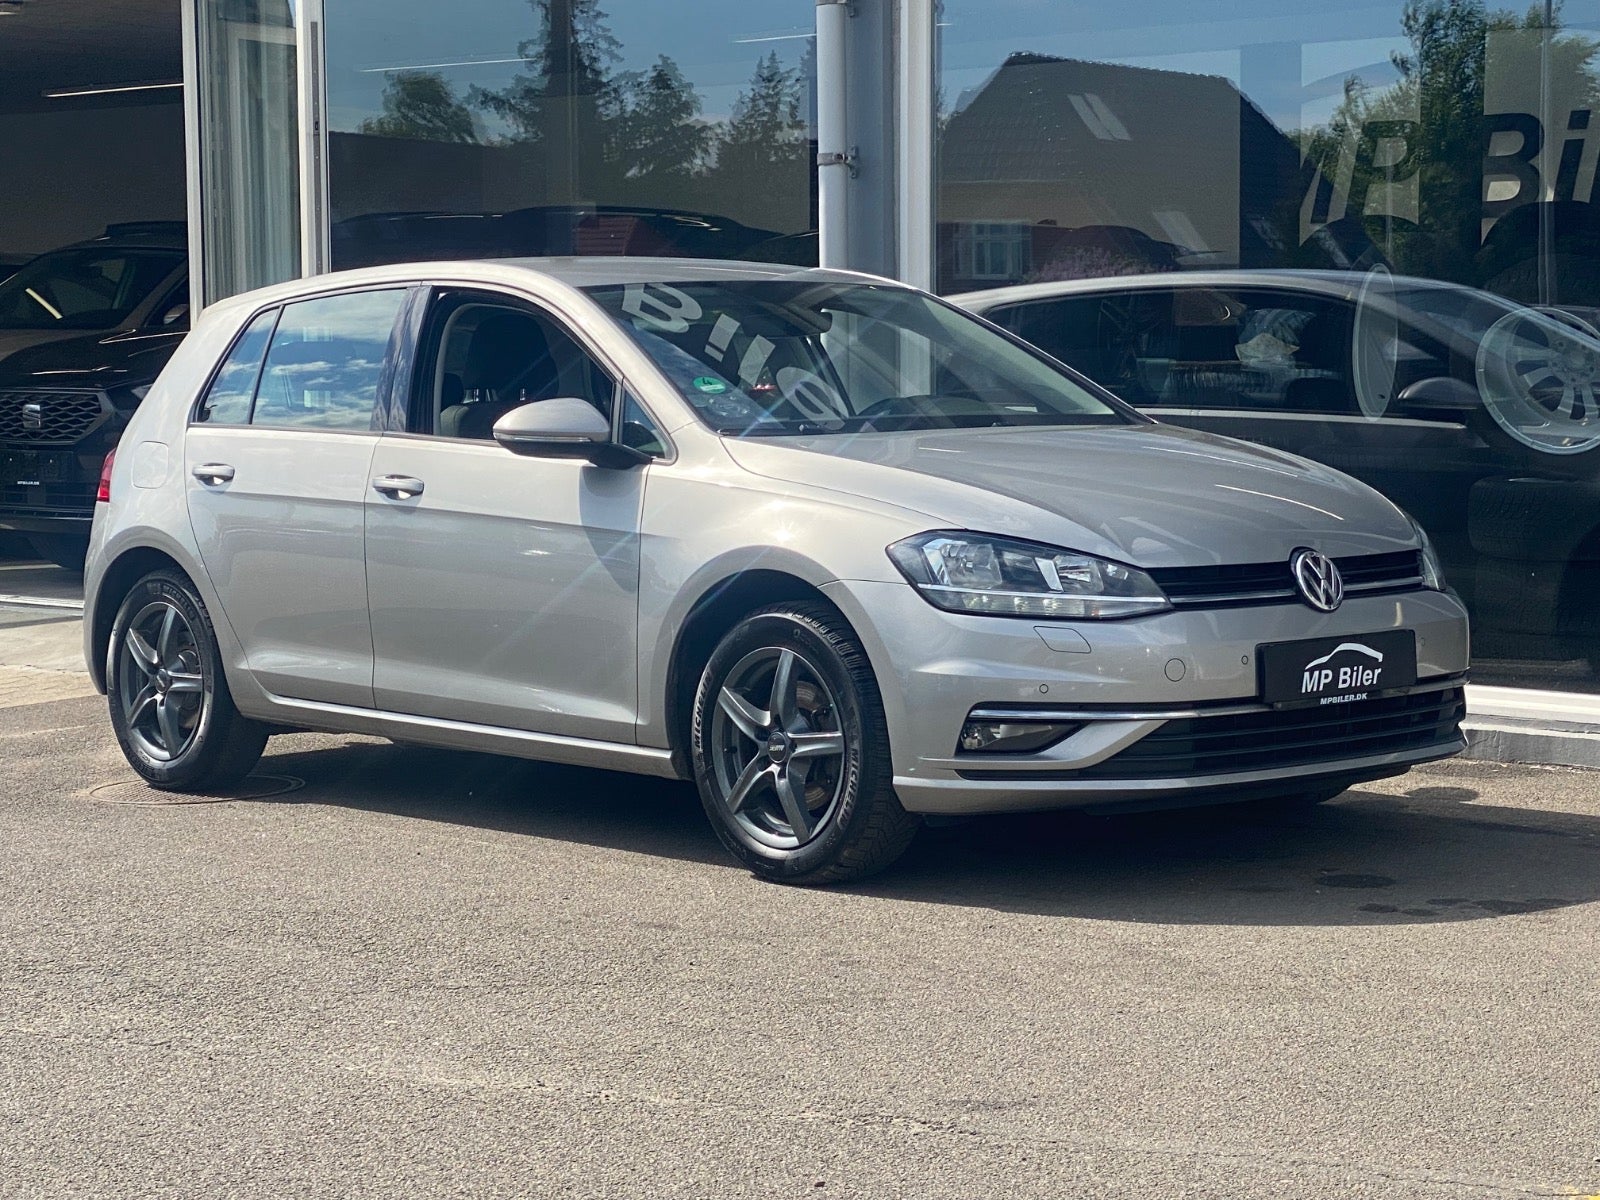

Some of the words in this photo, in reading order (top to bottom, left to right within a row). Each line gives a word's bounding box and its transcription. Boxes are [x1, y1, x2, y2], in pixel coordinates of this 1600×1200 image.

[1479, 109, 1600, 218] Bi
[1301, 669, 1333, 693] MP
[1338, 665, 1382, 689] Biler
[1320, 692, 1368, 705] MPBILER.DK
[694, 671, 713, 748] MICHELIN
